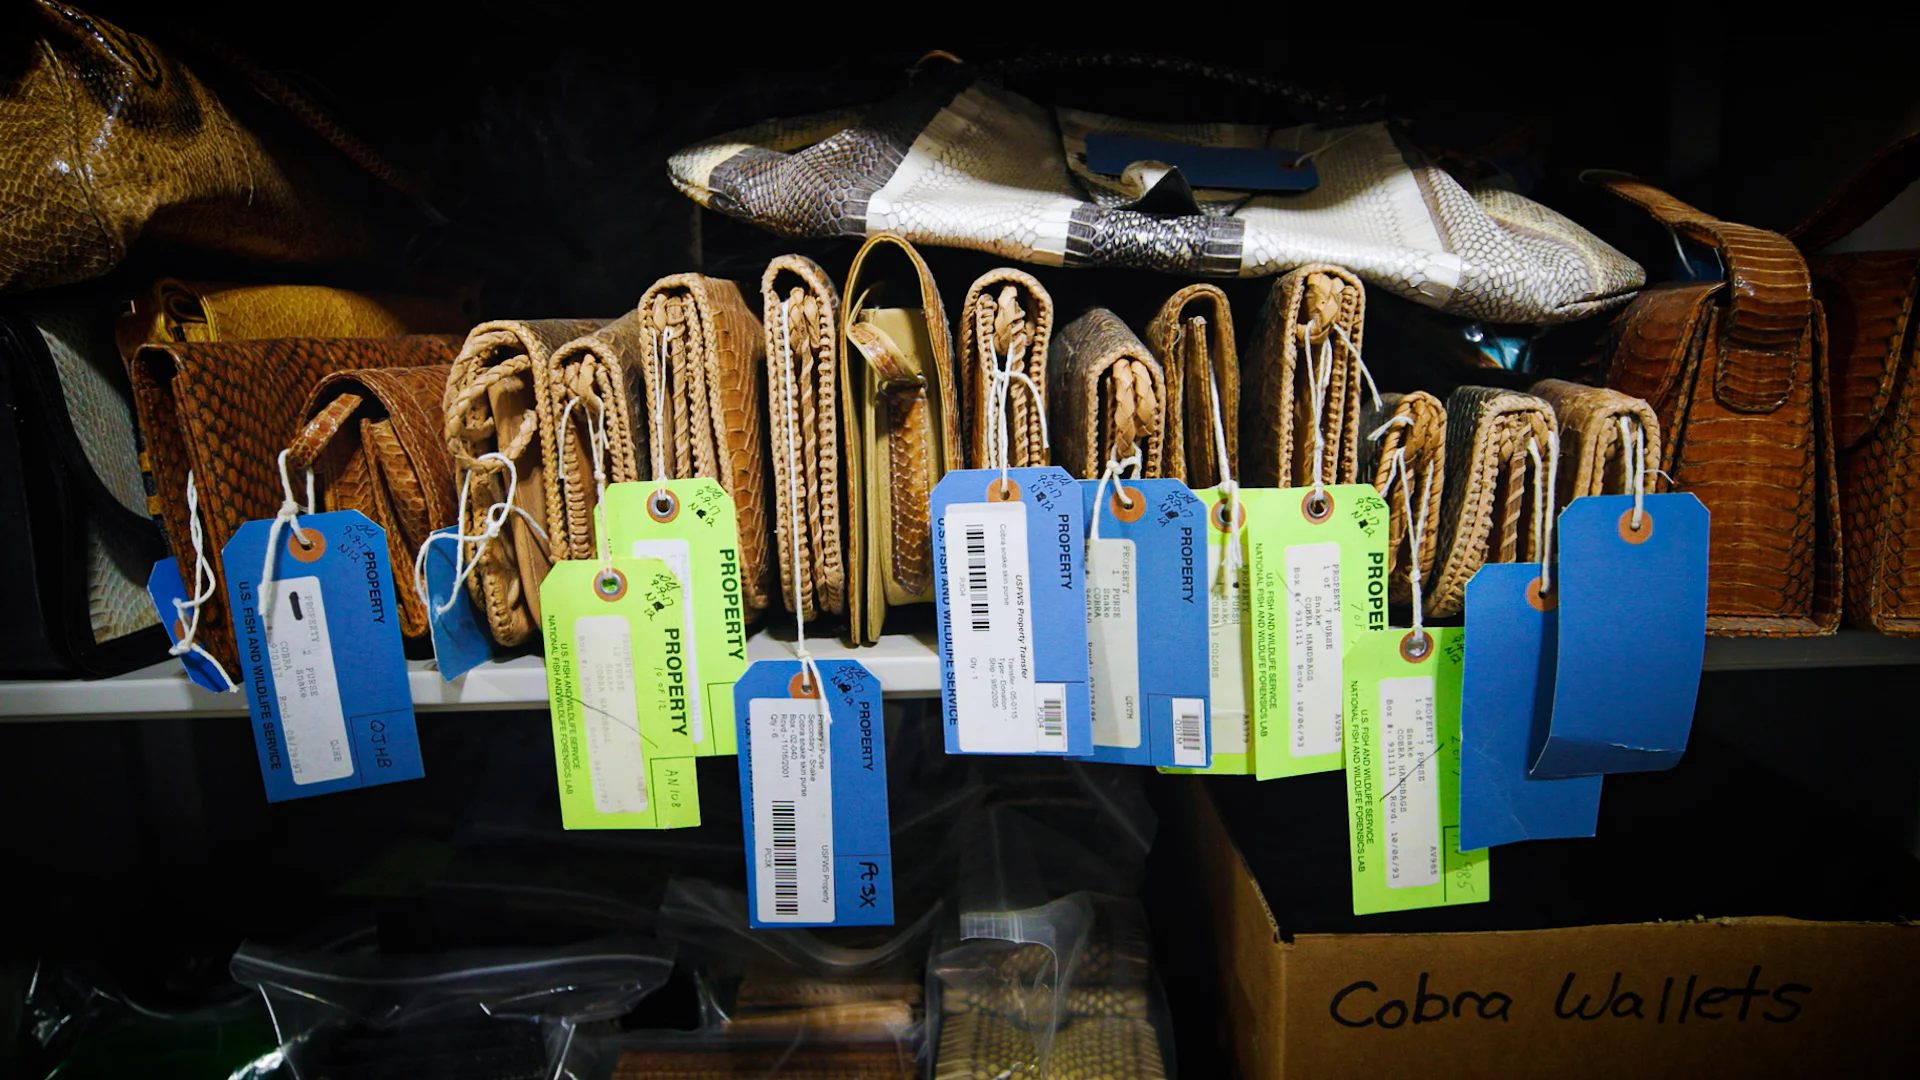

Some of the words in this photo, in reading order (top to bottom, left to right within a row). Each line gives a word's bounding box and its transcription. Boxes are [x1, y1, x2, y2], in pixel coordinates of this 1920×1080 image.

[1058, 514, 1072, 590] PROPERTY
[1180, 527, 1194, 605] PROPERTY
[1255, 543, 1263, 586] NATIONAL
[1122, 546, 1130, 594] PROPERTY
[1323, 577, 1330, 589] of
[237, 580, 252, 605] U.S.
[363, 551, 385, 626] PROPERTY
[941, 579, 952, 605] AND
[1015, 574, 1023, 606] USFWS
[1093, 587, 1102, 618] COBRA
[1103, 588, 1111, 618] Snake
[1241, 564, 1250, 614] PROPERTY
[1256, 588, 1264, 608] FISH
[1266, 591, 1274, 610] FISH
[1332, 564, 1341, 612] PROPERTY
[720, 548, 744, 661] PROPERTY
[1113, 588, 1121, 619] PURSE
[1211, 595, 1219, 625] COBRA
[1304, 597, 1312, 628] COBRA
[1314, 596, 1322, 626] Snake
[242, 607, 257, 634] FISH
[304, 595, 320, 643] PROPERTY
[1015, 608, 1025, 643] Property
[1257, 610, 1265, 628] AND
[1267, 613, 1275, 631] AND
[247, 636, 263, 663] AND
[548, 615, 559, 656] NATIONAL
[560, 643, 569, 657] U.S.
[943, 610, 955, 668] WILDLIFE
[1257, 629, 1266, 668] WILDLIFE
[279, 641, 293, 672] COBRA
[552, 657, 561, 676] FISH
[969, 657, 978, 669] Qty
[988, 657, 996, 673] Ship
[997, 658, 1006, 674] Type
[1019, 646, 1027, 679] Transfer
[1212, 642, 1220, 679] COLORS
[1268, 632, 1276, 671] WILDLIFE
[1305, 634, 1314, 681] HANDBAGS
[295, 668, 308, 699] Snake
[305, 667, 318, 698] PURSE
[562, 660, 571, 679] FISH
[664, 628, 687, 736] PROPERTY
[1008, 657, 1016, 685] Transfer
[252, 664, 273, 720] WILDLIFE
[554, 677, 563, 695] AND
[564, 680, 573, 697] AND
[946, 672, 959, 726] SERVICE
[1259, 670, 1267, 719] FORENSICS
[1269, 673, 1277, 709] SERVICE
[566, 698, 577, 735] WILDLIFE
[1350, 681, 1359, 723] NATIONAL
[1385, 699, 1393, 717] Box
[1415, 710, 1422, 721] of
[769, 714, 778, 727] Qty
[780, 714, 788, 732] Rcvd
[816, 714, 825, 742] Primary
[1260, 720, 1268, 737] LAB
[1360, 709, 1369, 726] U.S.
[1425, 697, 1434, 745] PROPERTY
[263, 722, 282, 771] SERVICE
[807, 714, 816, 752] Secondary
[858, 701, 873, 772] PROPERTY
[1352, 724, 1360, 743] FISH
[1361, 727, 1370, 747] FISH
[1396, 729, 1405, 759] COBRA
[1406, 728, 1415, 758] Snake
[560, 733, 572, 778] FORENSICS
[570, 736, 580, 770] SERVICE
[799, 738, 807, 759] snake
[818, 749, 826, 770] Purse
[1353, 745, 1361, 764] AND
[1362, 748, 1370, 767] AND
[809, 759, 817, 782] Snake
[1417, 752, 1425, 782] PURSE
[565, 779, 573, 795] LAB
[799, 777, 807, 797] purse
[1353, 765, 1363, 804] WILDLIFE
[1363, 768, 1372, 807] WILDLIFE
[1398, 765, 1407, 813] HANDBAGS
[1355, 806, 1365, 854] FORENSICS
[1365, 809, 1374, 845] SERVICE
[821, 845, 829, 873] USFWS
[1357, 856, 1365, 873] LAB
[820, 874, 830, 904] Property
[1330, 973, 1511, 1029] Cobra
[1554, 965, 1812, 1025] Wallets
